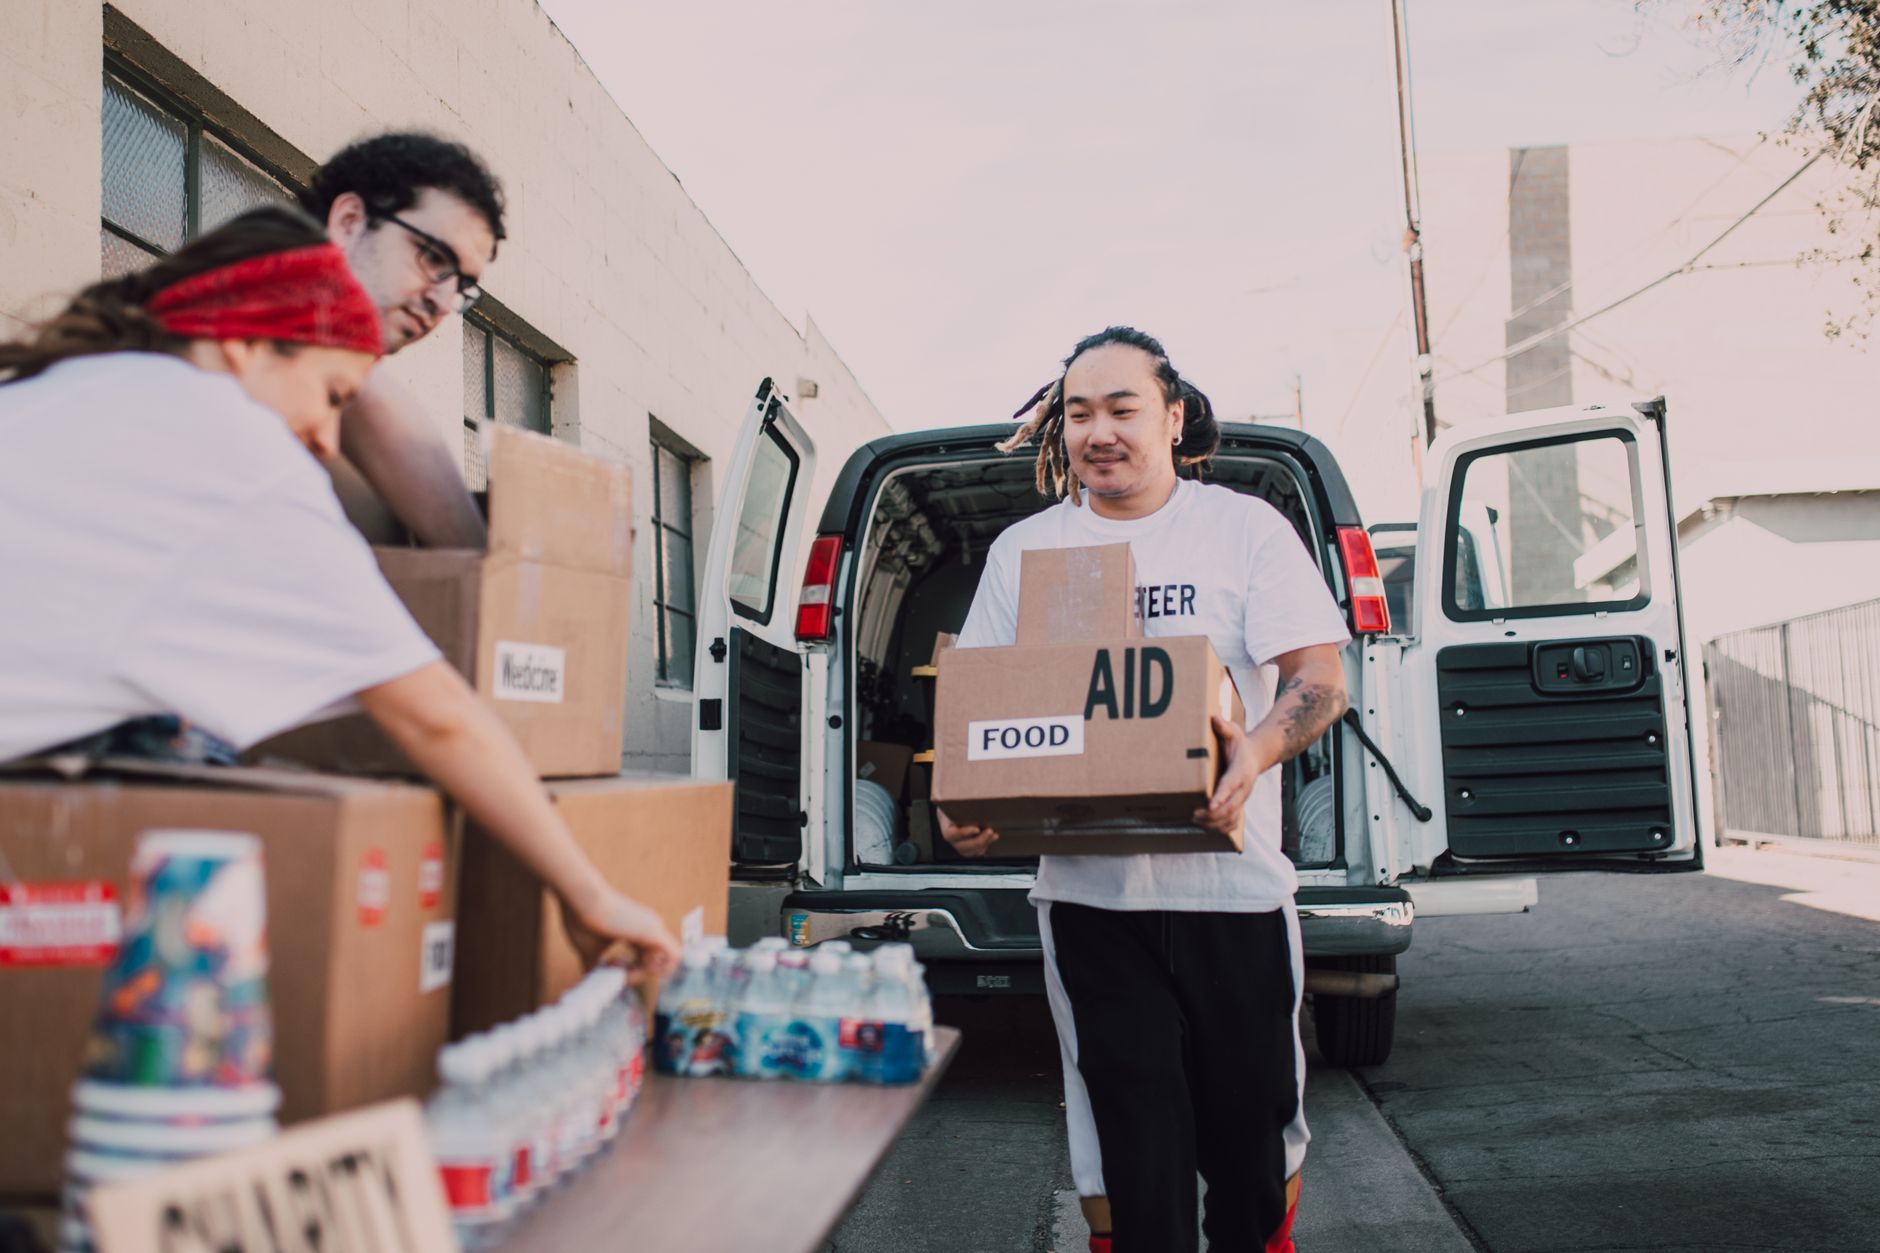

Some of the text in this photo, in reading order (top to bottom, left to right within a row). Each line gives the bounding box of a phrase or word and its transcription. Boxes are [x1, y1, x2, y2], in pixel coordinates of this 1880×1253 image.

[1142, 584, 1196, 619] EER
[1084, 646, 1174, 720] AID
[982, 724, 1070, 751] FOOD
